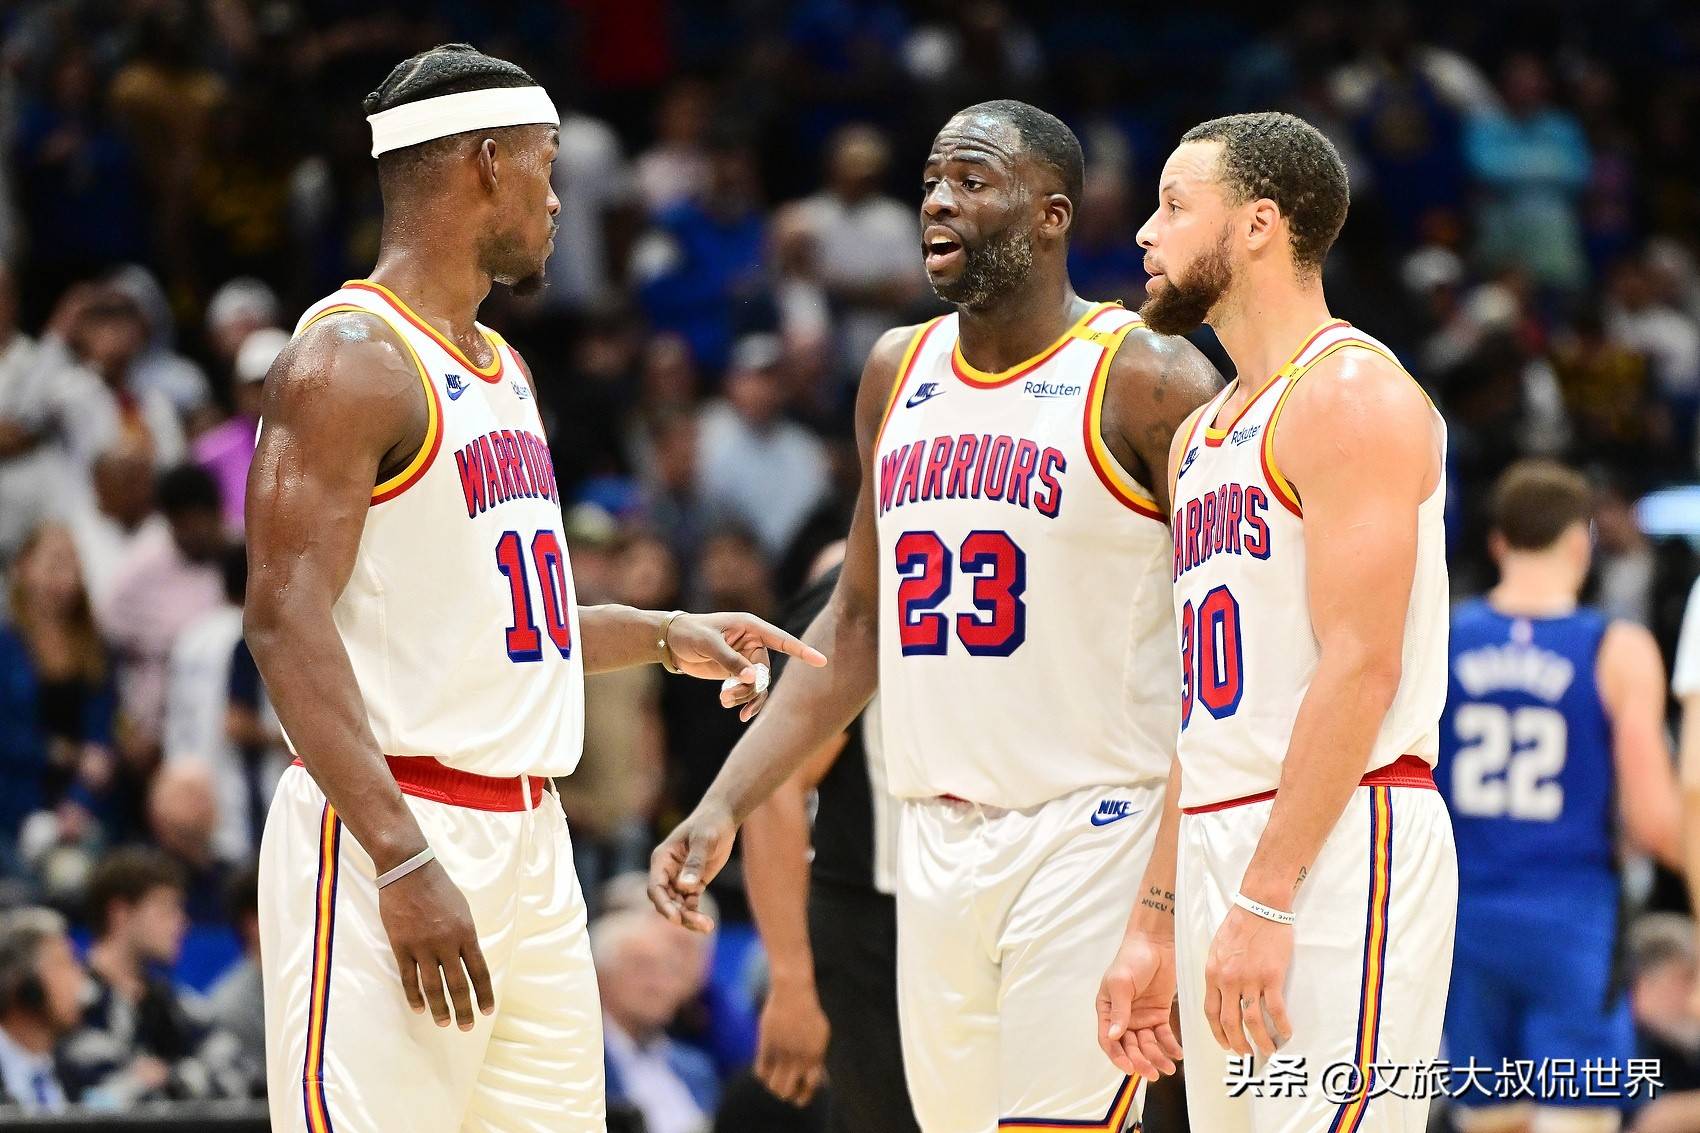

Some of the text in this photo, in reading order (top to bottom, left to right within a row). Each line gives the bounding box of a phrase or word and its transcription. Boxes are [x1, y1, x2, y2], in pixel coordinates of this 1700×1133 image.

[1024, 380, 1081, 396] Rakuten
[454, 429, 559, 519] WARRIOR
[880, 434, 1067, 519] WARRIORS
[1173, 483, 1271, 583] ARRORS
[495, 529, 571, 663] 10
[895, 530, 1026, 657] 23
[1181, 584, 1243, 733] 30
[1098, 800, 1132, 815] NIKE
[1453, 702, 1568, 822] 22
